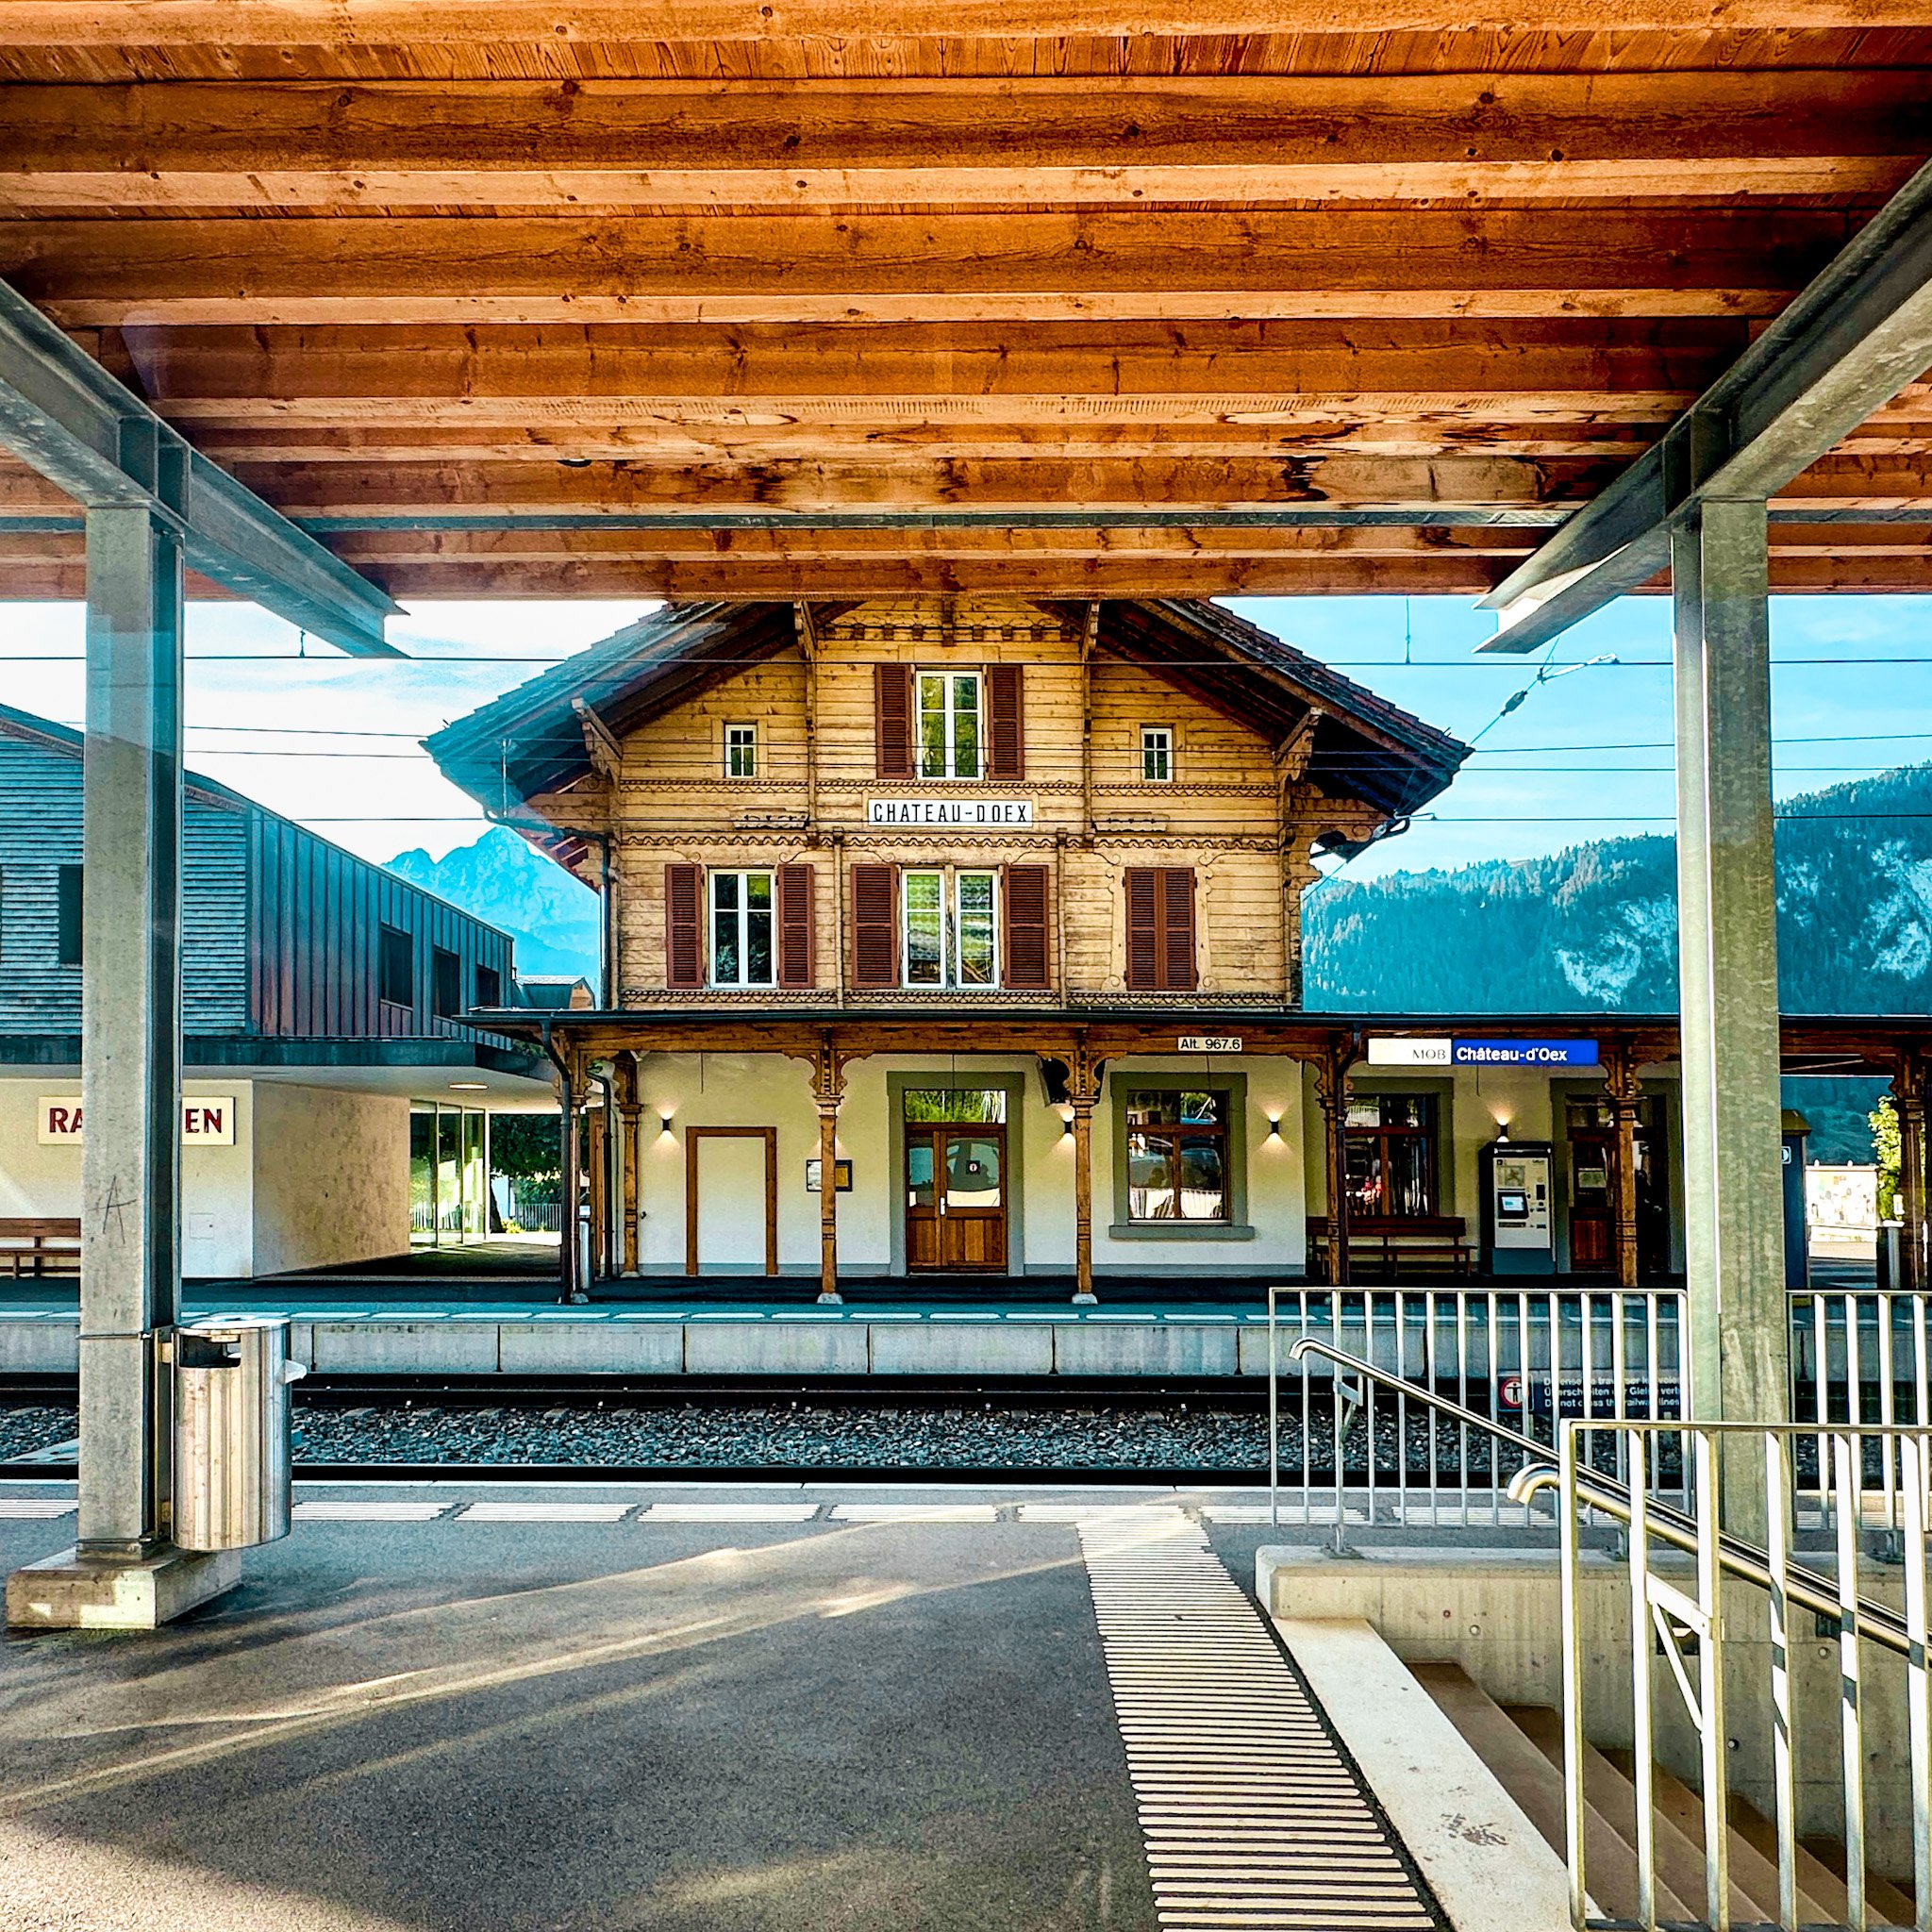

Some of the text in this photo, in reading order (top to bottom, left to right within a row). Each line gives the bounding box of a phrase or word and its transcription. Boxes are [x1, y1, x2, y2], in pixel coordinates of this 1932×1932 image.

[1180, 1039, 1241, 1049] Alt. 967.6
[1412, 1049, 1446, 1060] MOB
[1457, 1046, 1568, 1061] Château-d'Oex
